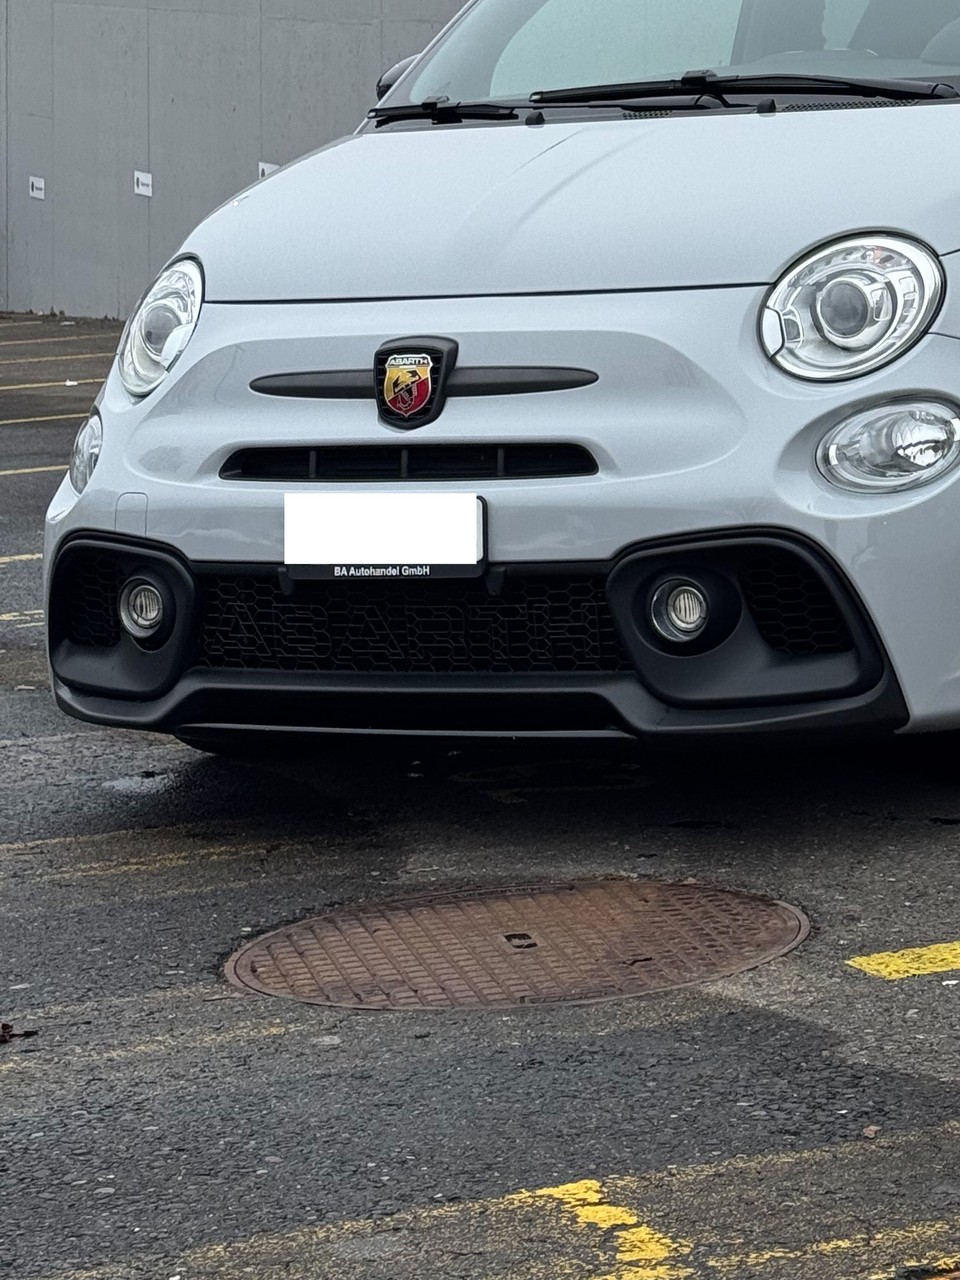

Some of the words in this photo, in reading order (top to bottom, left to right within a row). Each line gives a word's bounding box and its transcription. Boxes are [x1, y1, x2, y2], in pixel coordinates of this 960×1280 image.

[389, 357, 428, 365] ABARTH
[334, 566, 348, 577] BA
[349, 566, 400, 577] Autohandel
[401, 565, 430, 576] GmbH
[206, 602, 601, 659] ABARTH
